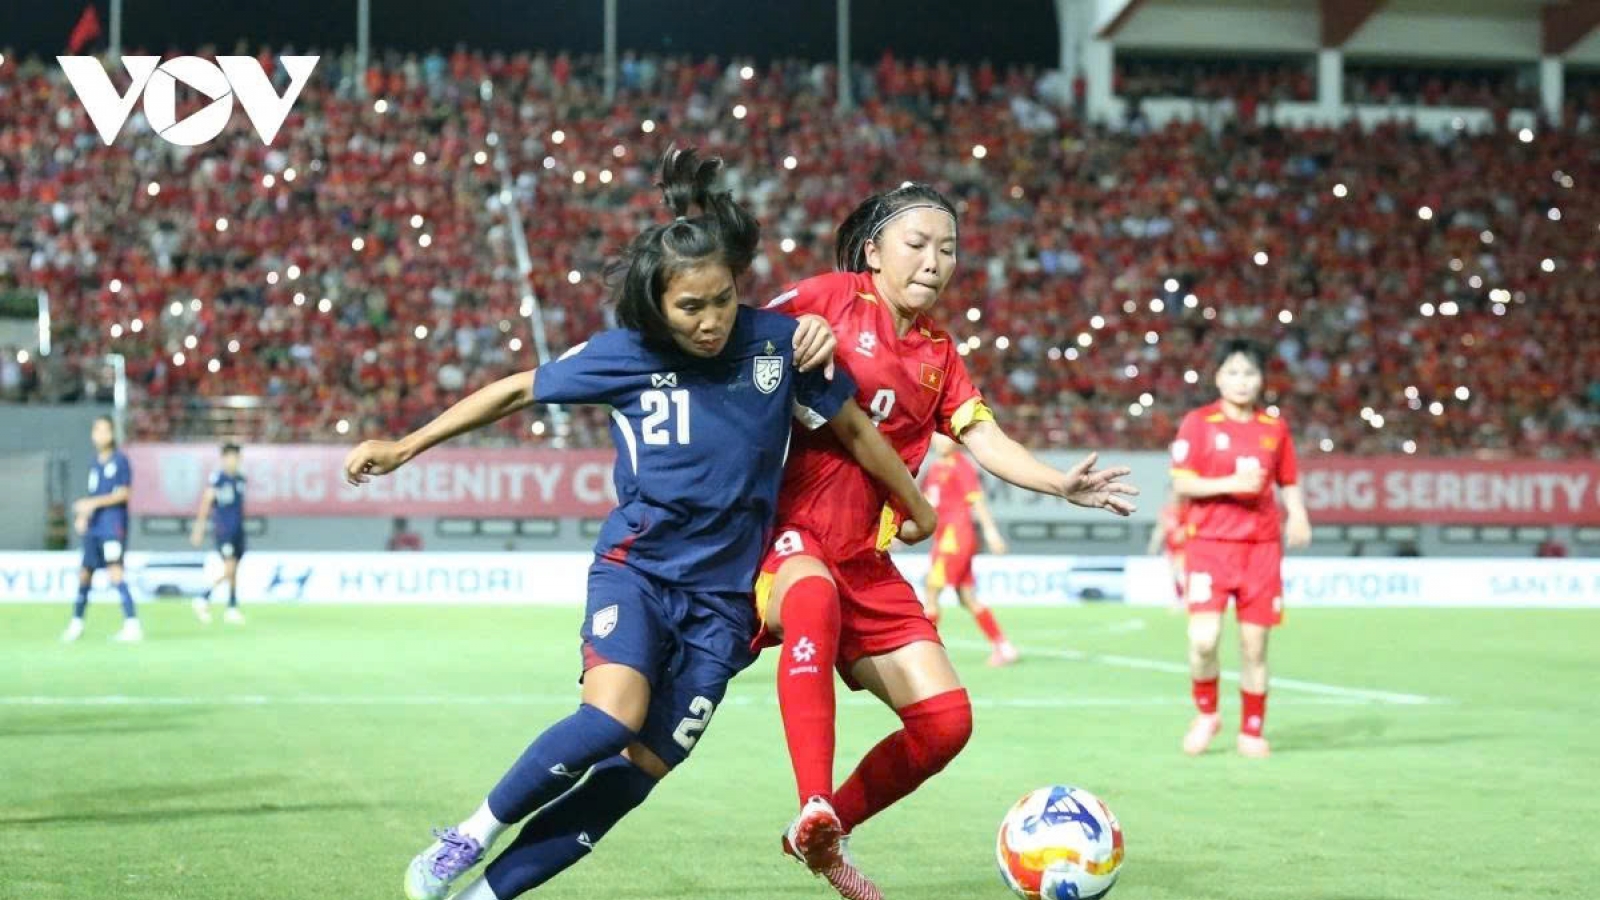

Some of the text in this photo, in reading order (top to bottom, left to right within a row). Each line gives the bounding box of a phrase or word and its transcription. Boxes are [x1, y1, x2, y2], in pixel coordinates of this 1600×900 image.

[640, 389, 690, 445] 21
[870, 388, 896, 427] 9
[1302, 468, 1590, 512] SIG SERENITY
[774, 530, 805, 557] 9
[339, 566, 524, 594] HYUNDAI
[672, 695, 714, 752] 2
